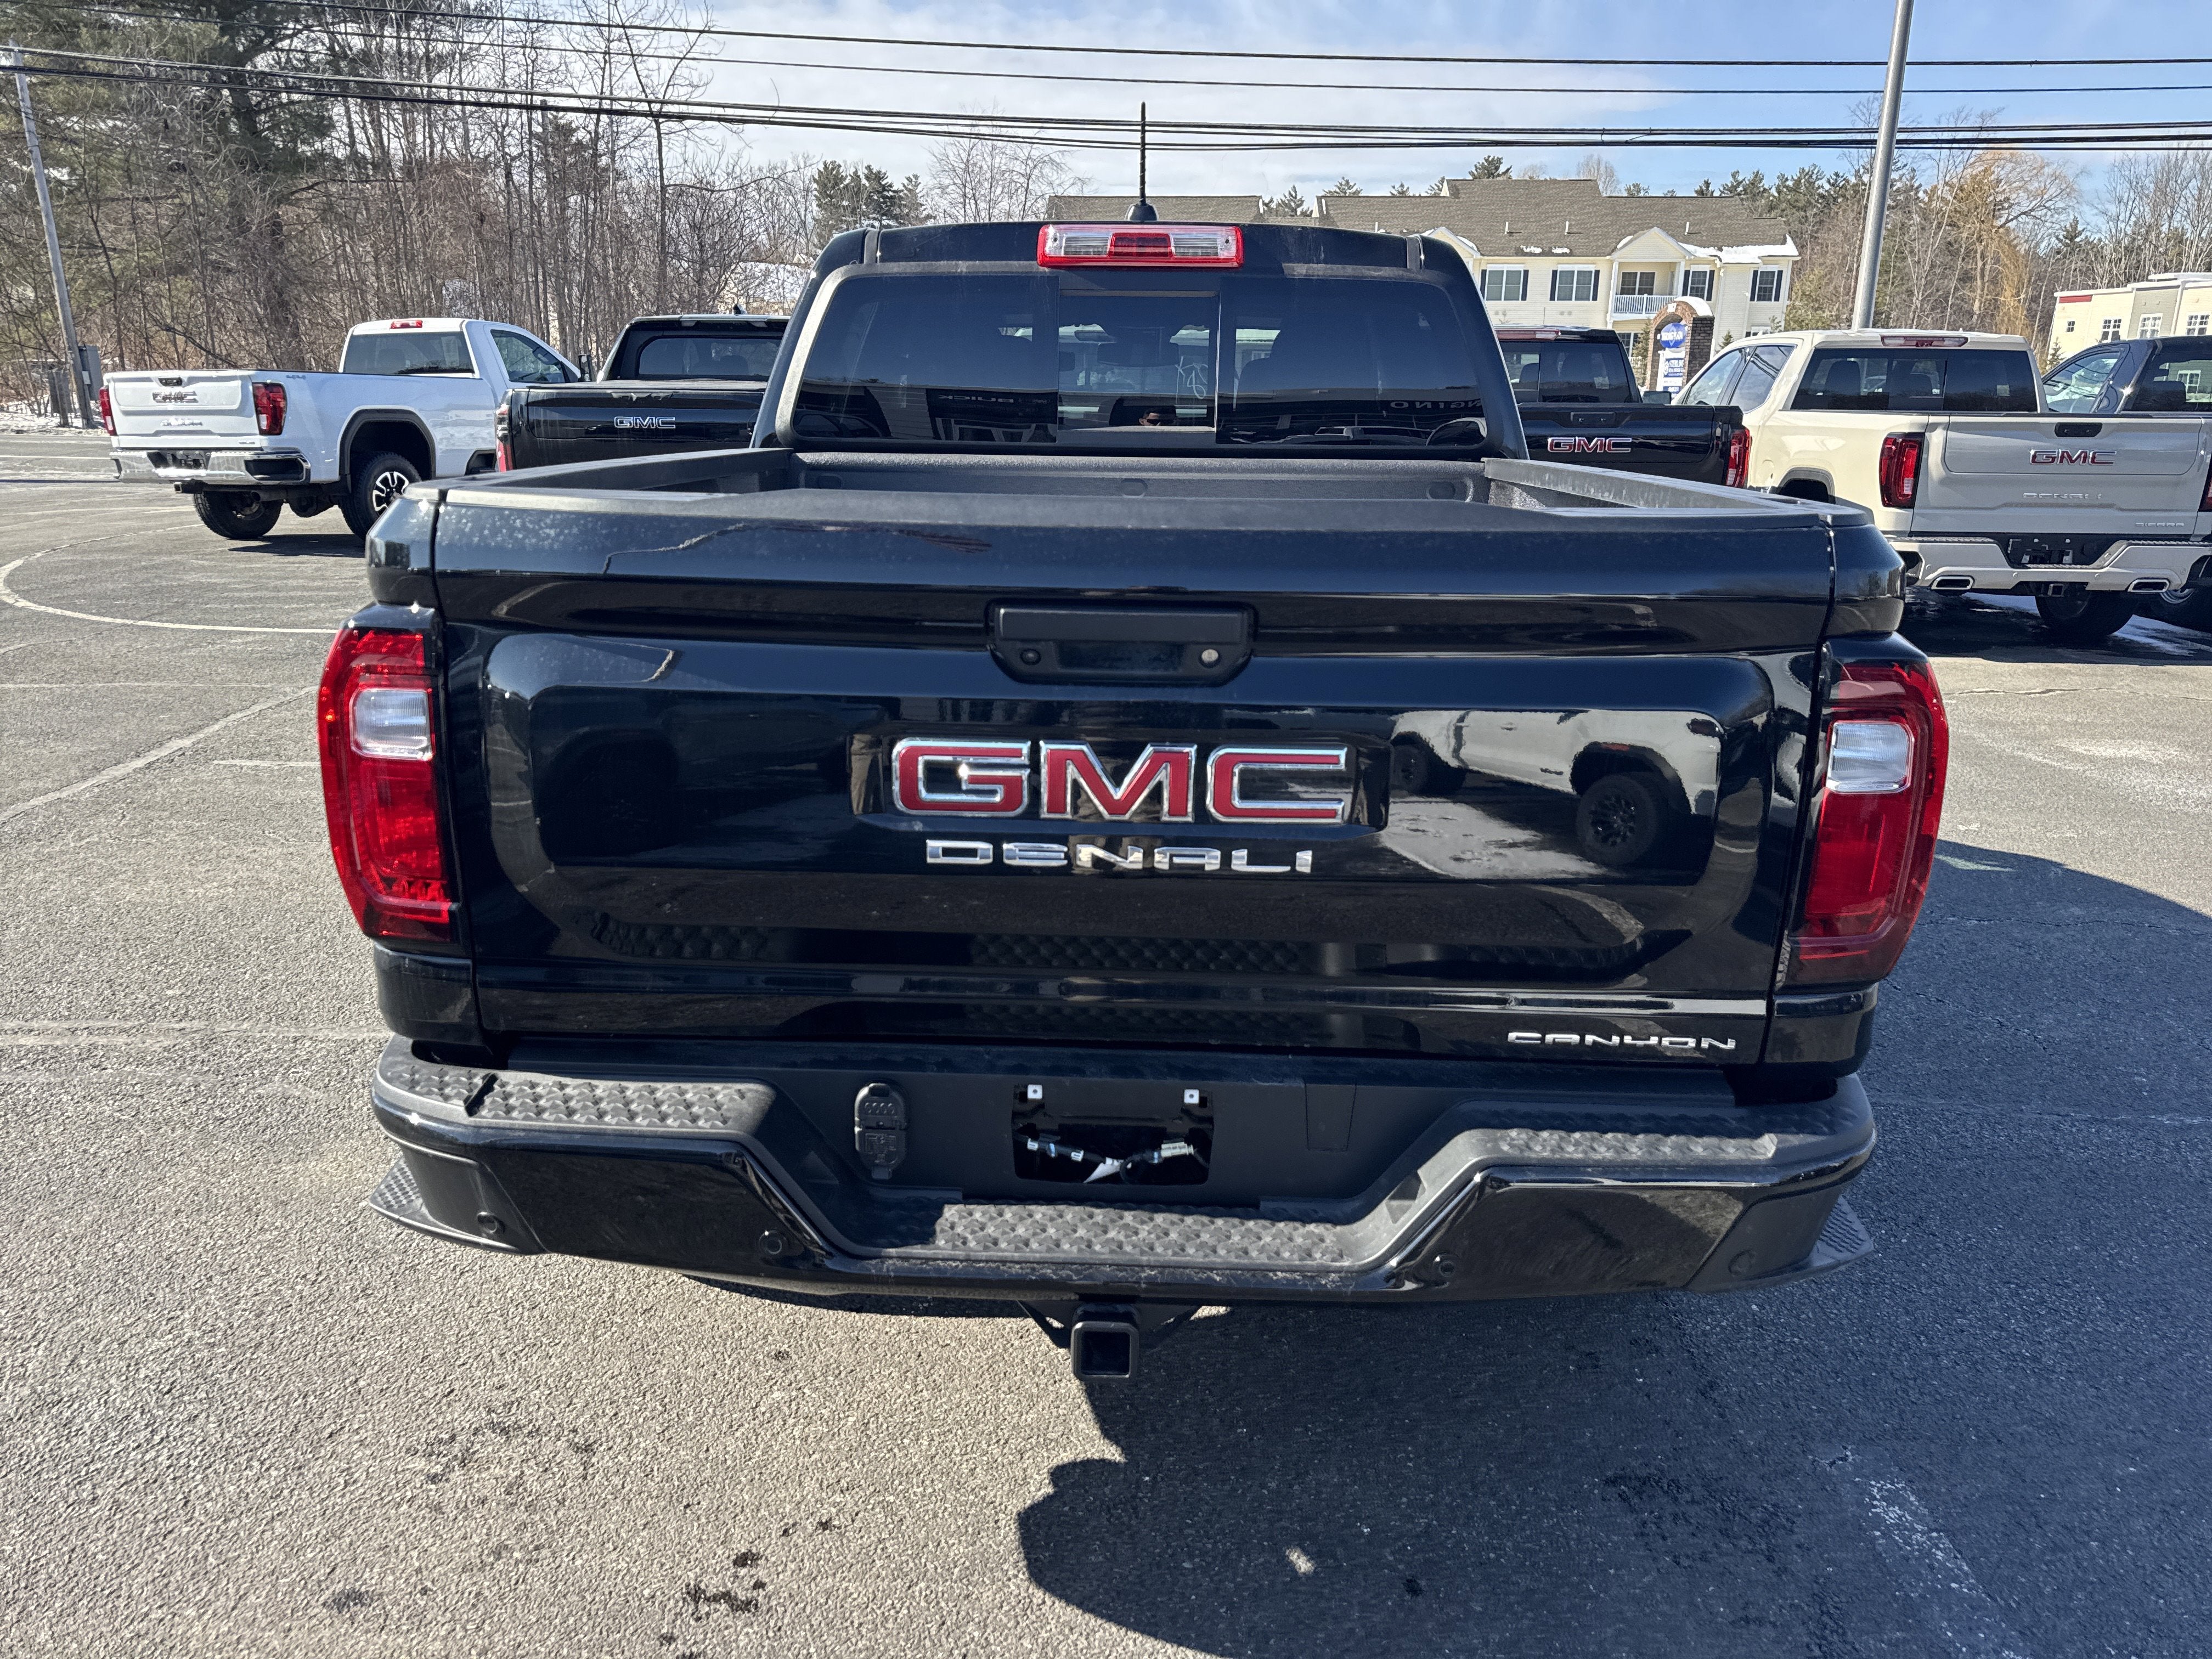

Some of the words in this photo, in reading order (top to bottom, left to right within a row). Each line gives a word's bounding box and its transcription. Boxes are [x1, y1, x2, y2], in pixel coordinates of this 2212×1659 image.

[614, 416, 676, 428] GMC
[1548, 437, 1632, 453] GMC
[2029, 449, 2117, 465] GMC
[891, 737, 1348, 825] GMC
[926, 839, 1313, 874] DENALI
[1508, 1031, 1736, 1049] CANYON
